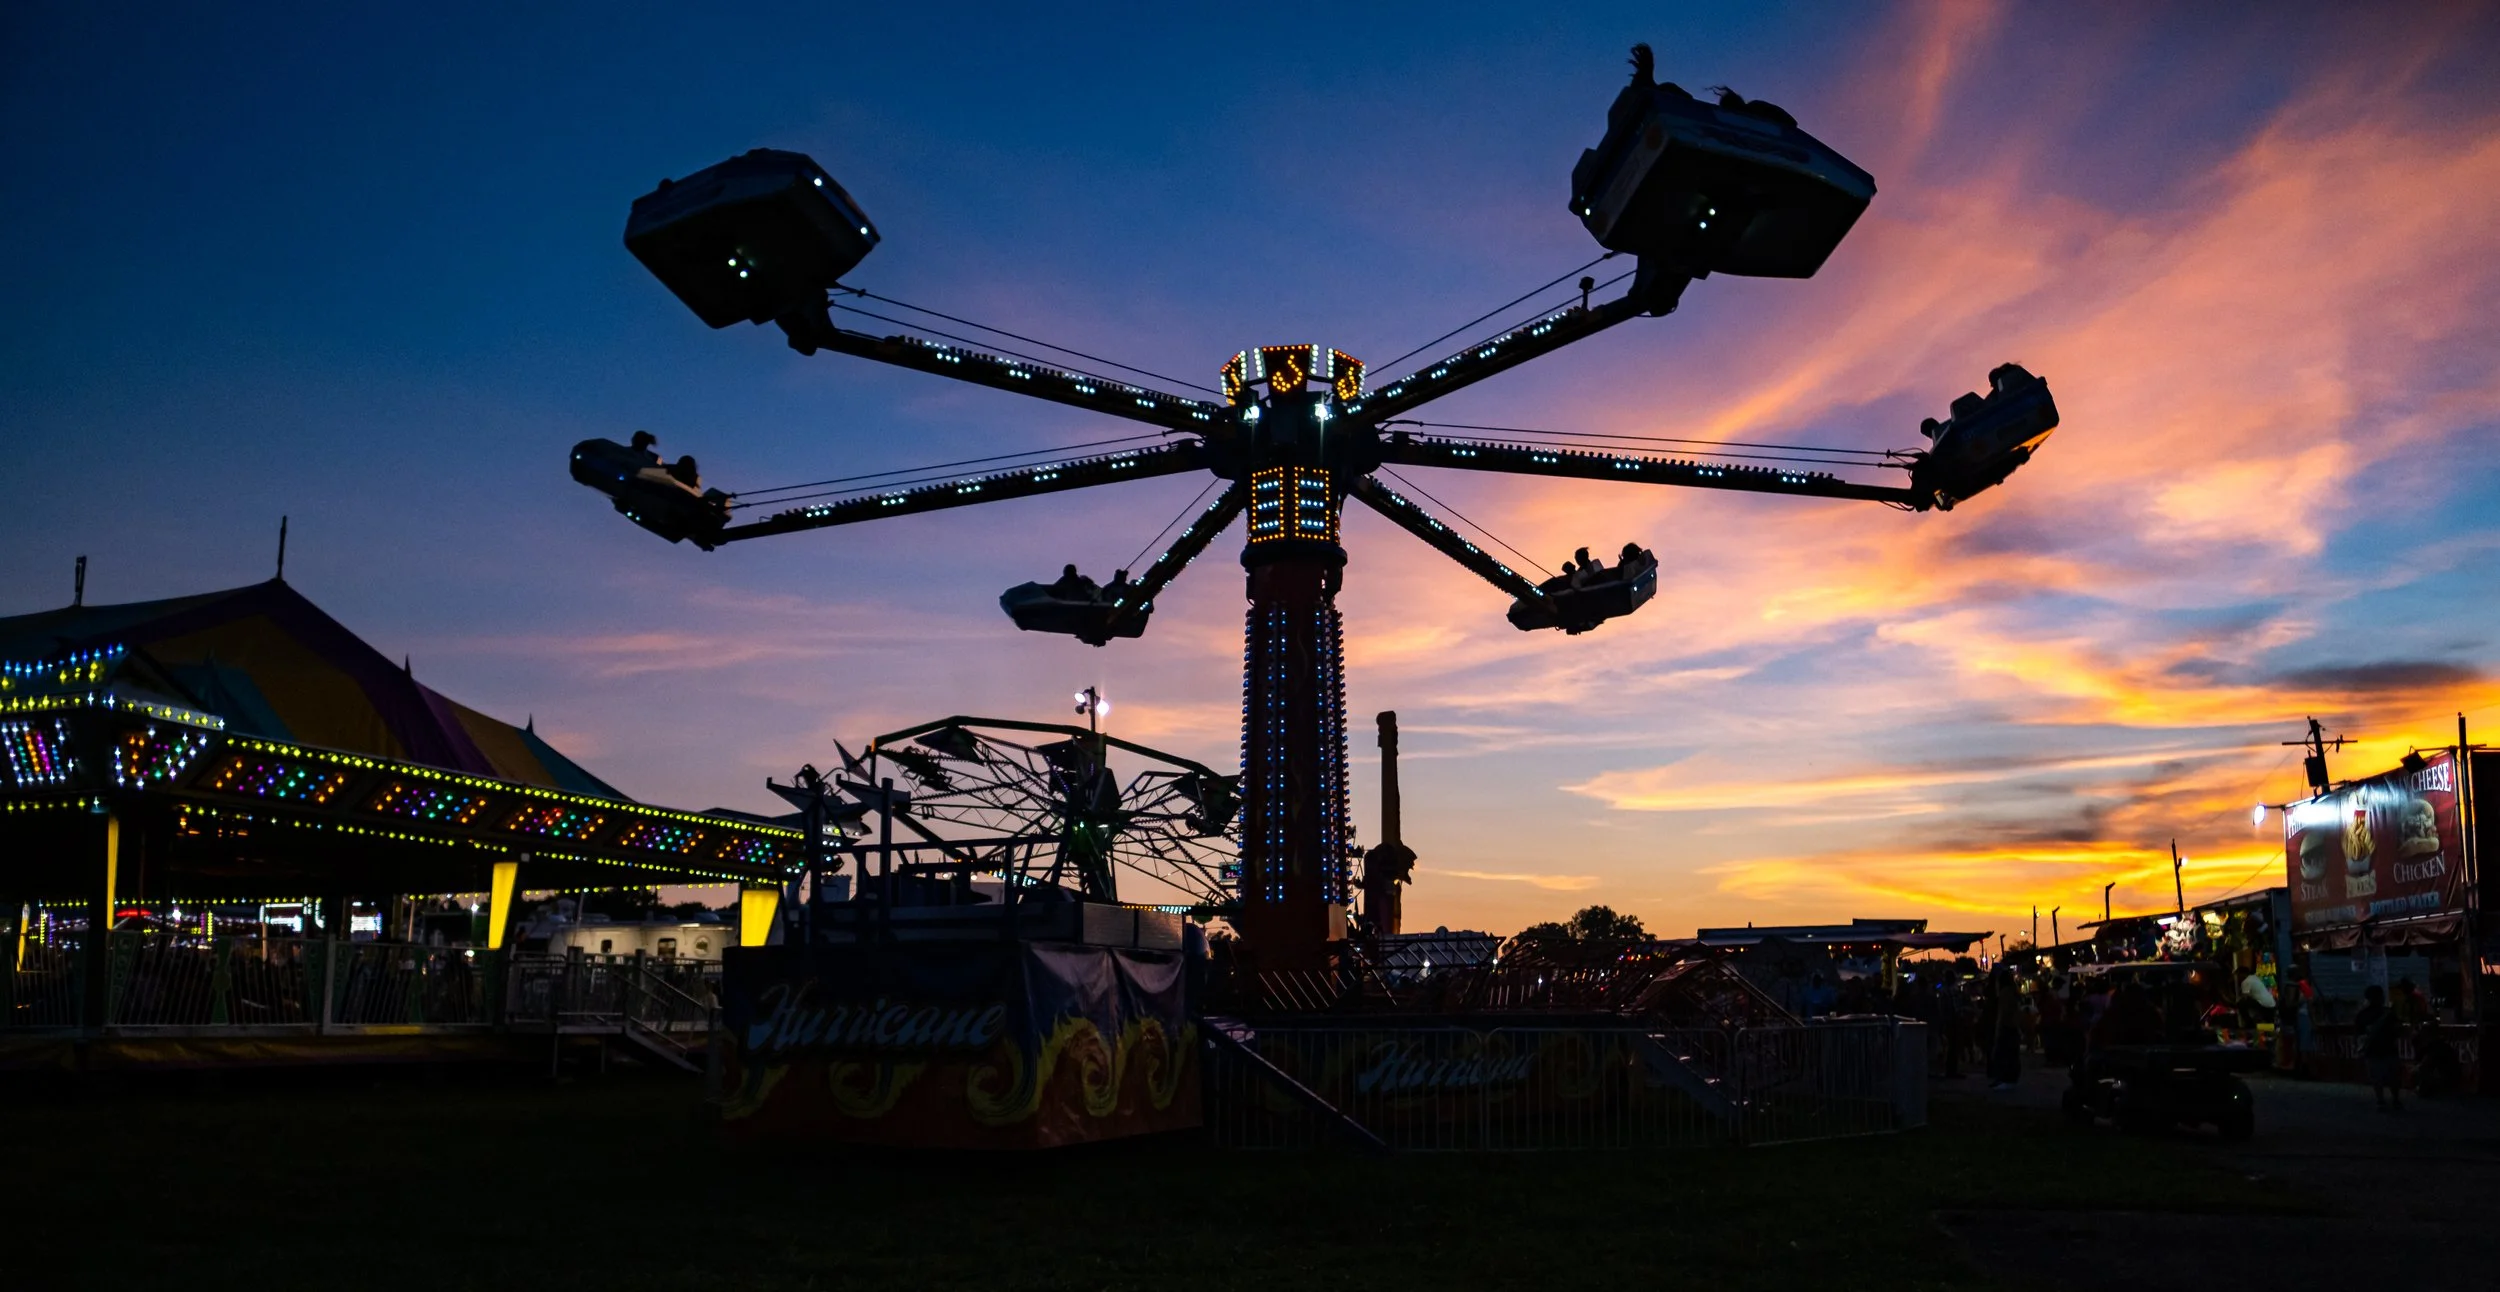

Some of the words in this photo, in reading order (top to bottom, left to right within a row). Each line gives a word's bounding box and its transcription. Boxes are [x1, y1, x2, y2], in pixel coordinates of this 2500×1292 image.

[2411, 762, 2452, 792] CHEESE
[2393, 851, 2446, 884] CHICKEN
[747, 976, 1006, 1051] Hurricane
